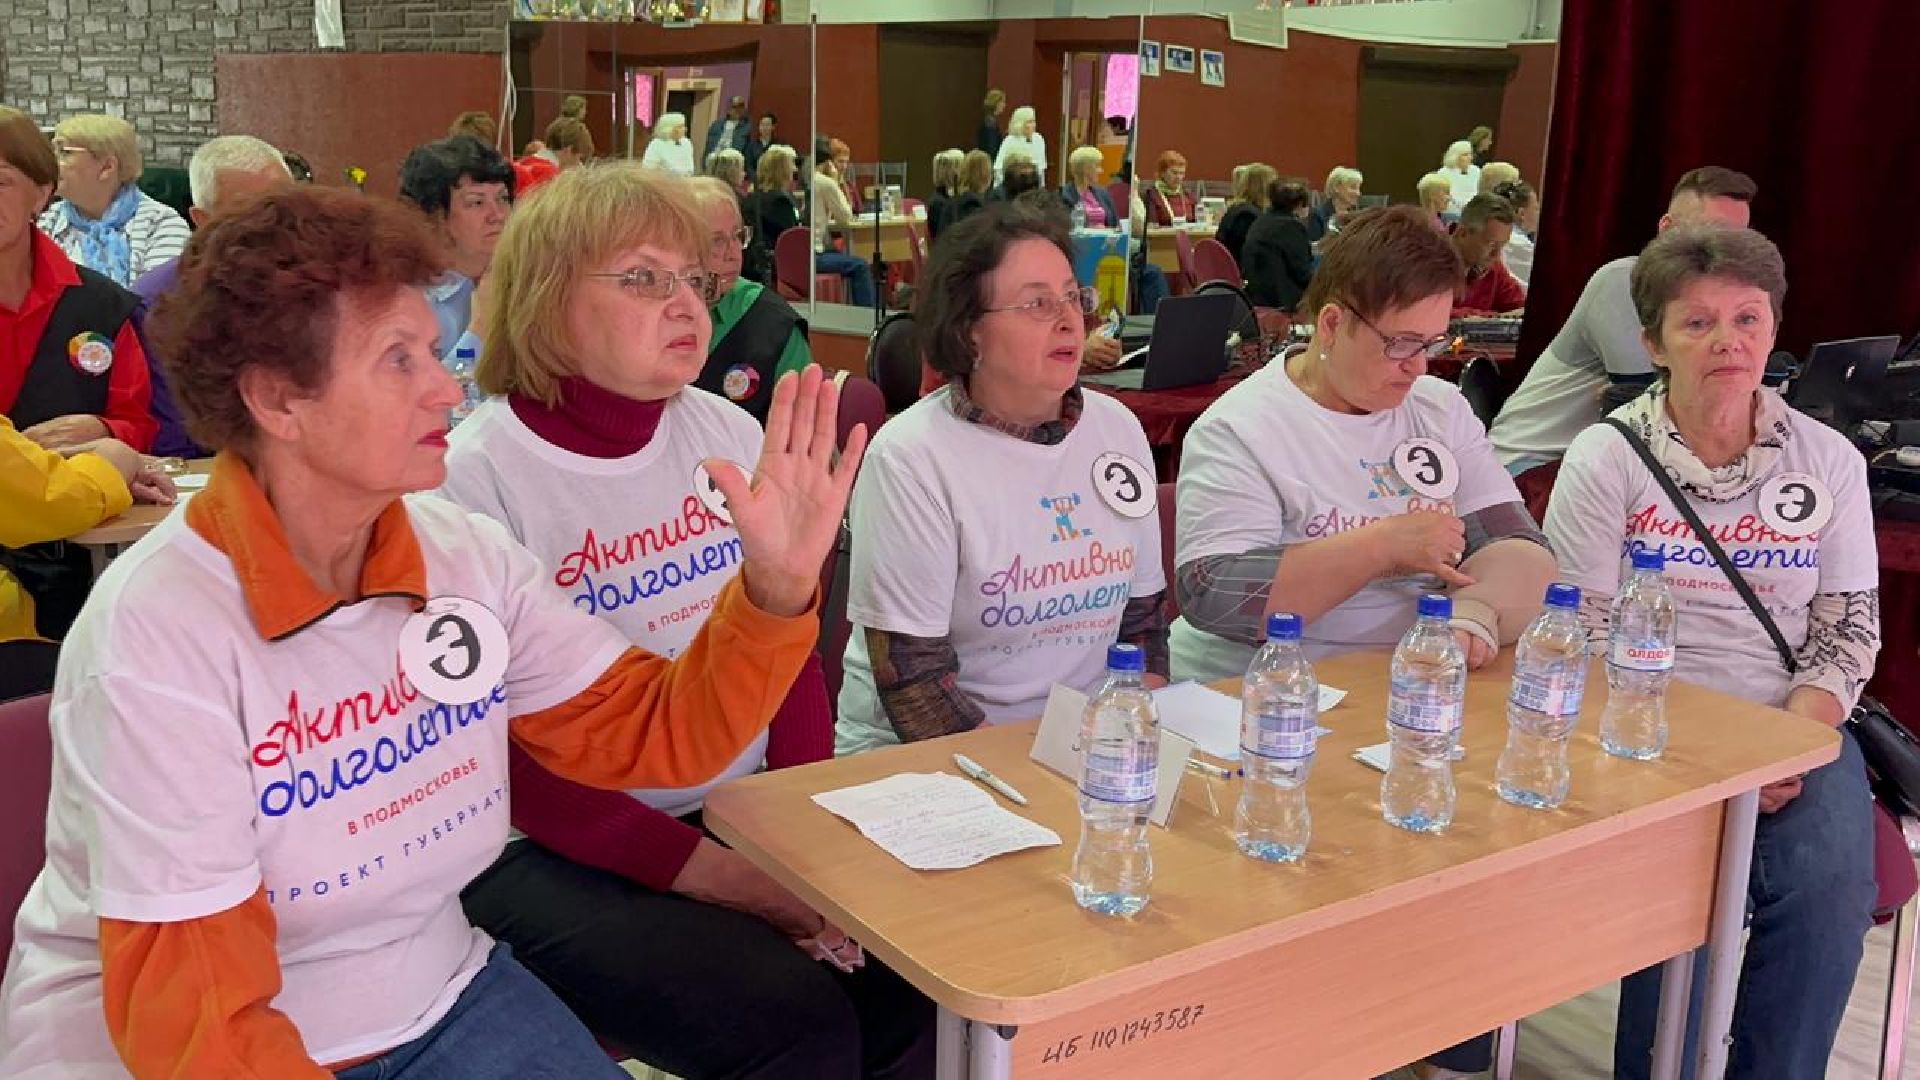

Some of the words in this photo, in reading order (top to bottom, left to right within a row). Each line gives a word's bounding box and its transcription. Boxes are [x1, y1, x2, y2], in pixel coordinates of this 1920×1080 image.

[1104, 462, 1142, 503] Э
[1408, 446, 1443, 485] Э
[1775, 482, 1817, 523] Э
[426, 614, 481, 680] Э
[363, 756, 479, 829] ПОДМОСКОВЬЕ
[403, 779, 508, 856] ГУБЕРНАТ
